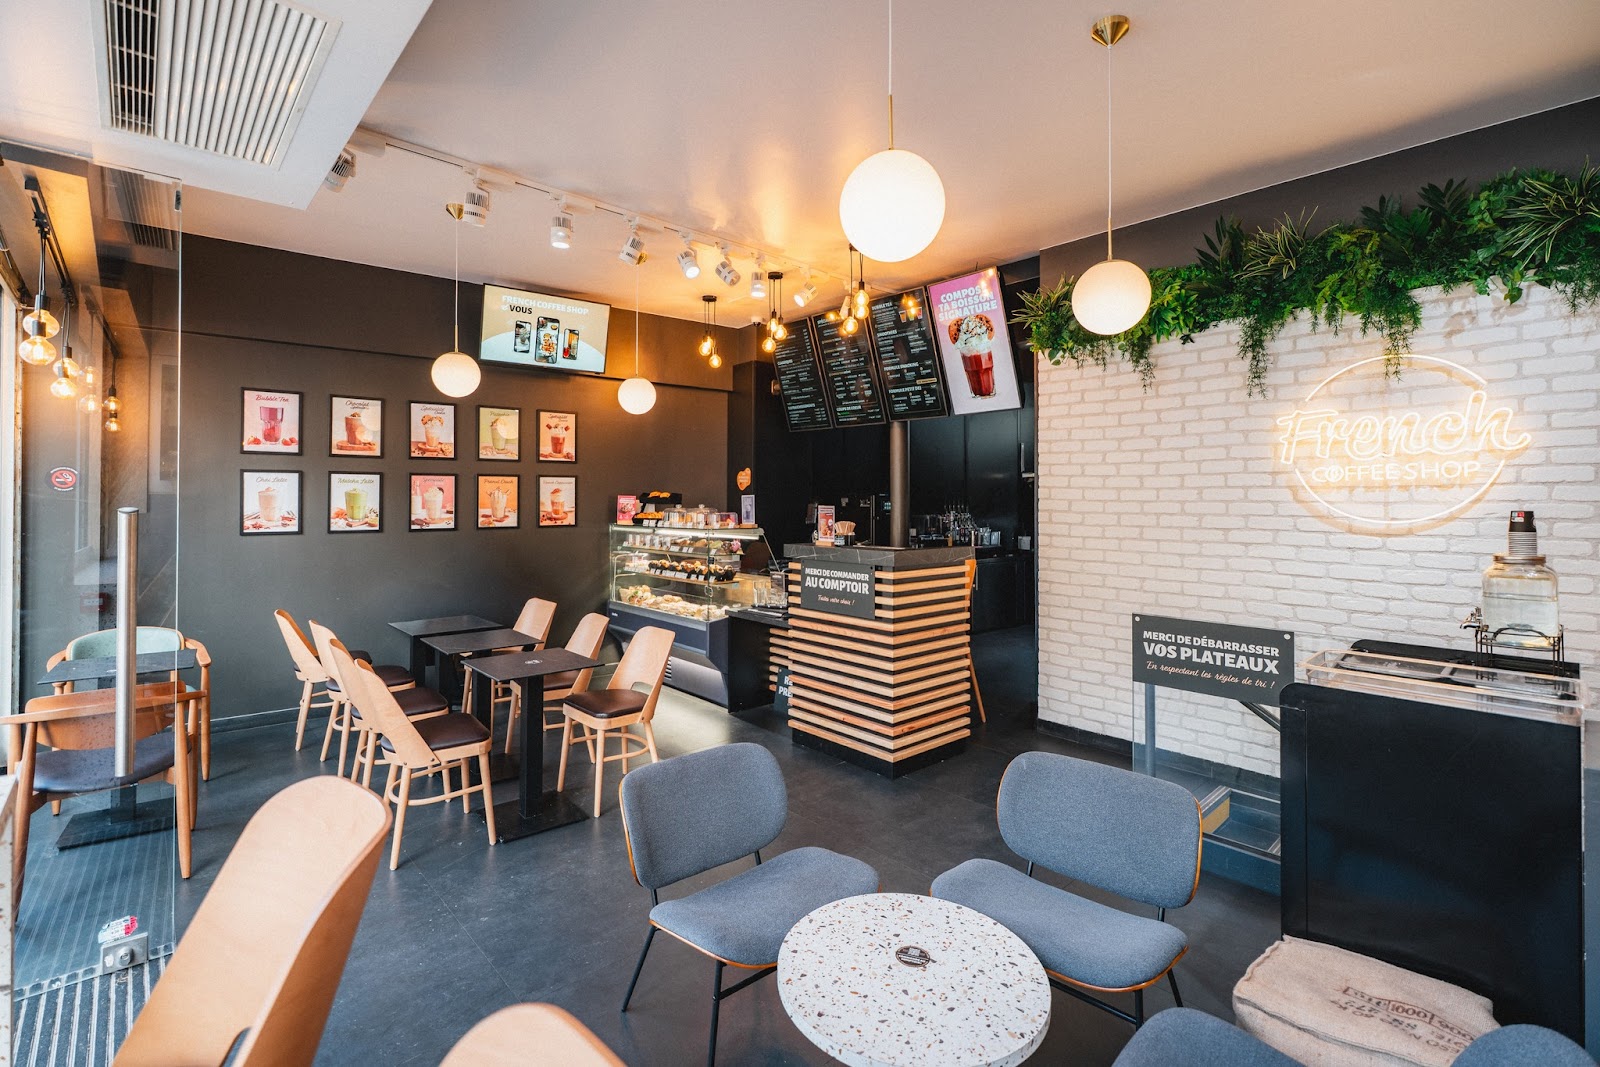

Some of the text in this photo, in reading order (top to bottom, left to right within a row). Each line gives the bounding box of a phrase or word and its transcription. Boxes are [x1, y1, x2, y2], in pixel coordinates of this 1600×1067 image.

[938, 292, 995, 312] TA BOISSON
[940, 284, 988, 303] COMPOS
[502, 295, 589, 315] FRENCH COFFEE SHOP
[509, 304, 533, 315] VOUS
[938, 300, 998, 321] SIGNATURE
[1276, 390, 1532, 465] French
[1311, 460, 1481, 483] COFFEE SHOP
[805, 567, 869, 581] MERCI DE COMMANDER
[805, 576, 869, 595] AU COMPTOIR
[1143, 630, 1280, 657] MERCI DE DÉBARRASSER
[1143, 641, 1280, 675] VOS PLATEAUX
[1146, 660, 1275, 689] En respectant les règles de tri !
